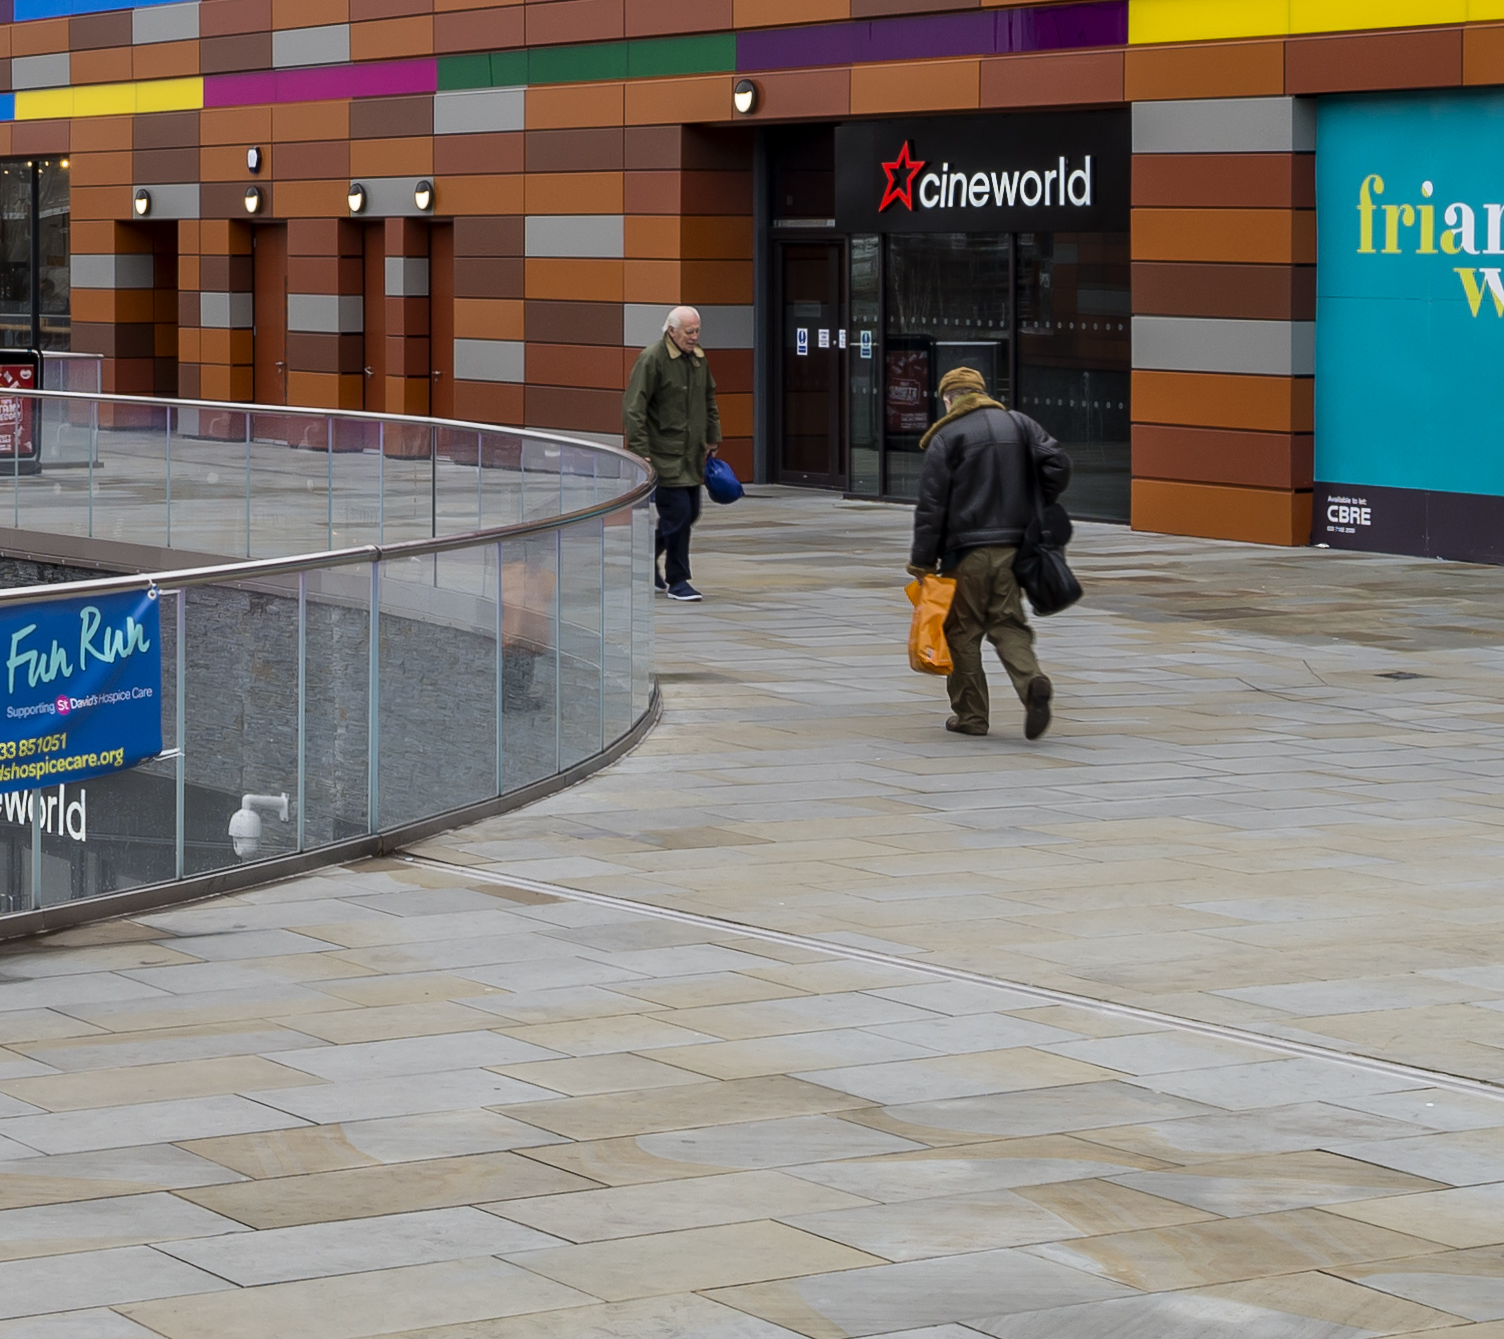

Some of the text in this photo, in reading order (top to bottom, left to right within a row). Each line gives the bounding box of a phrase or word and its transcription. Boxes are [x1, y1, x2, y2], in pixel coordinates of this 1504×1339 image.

[918, 155, 1092, 209] cineworld
[1327, 505, 1372, 526] CBRE
[6, 623, 73, 694] Fun
[79, 605, 151, 671] Run
[6, 686, 153, 718] Supporting St David's Hospice Care
[18, 731, 67, 758] 851051
